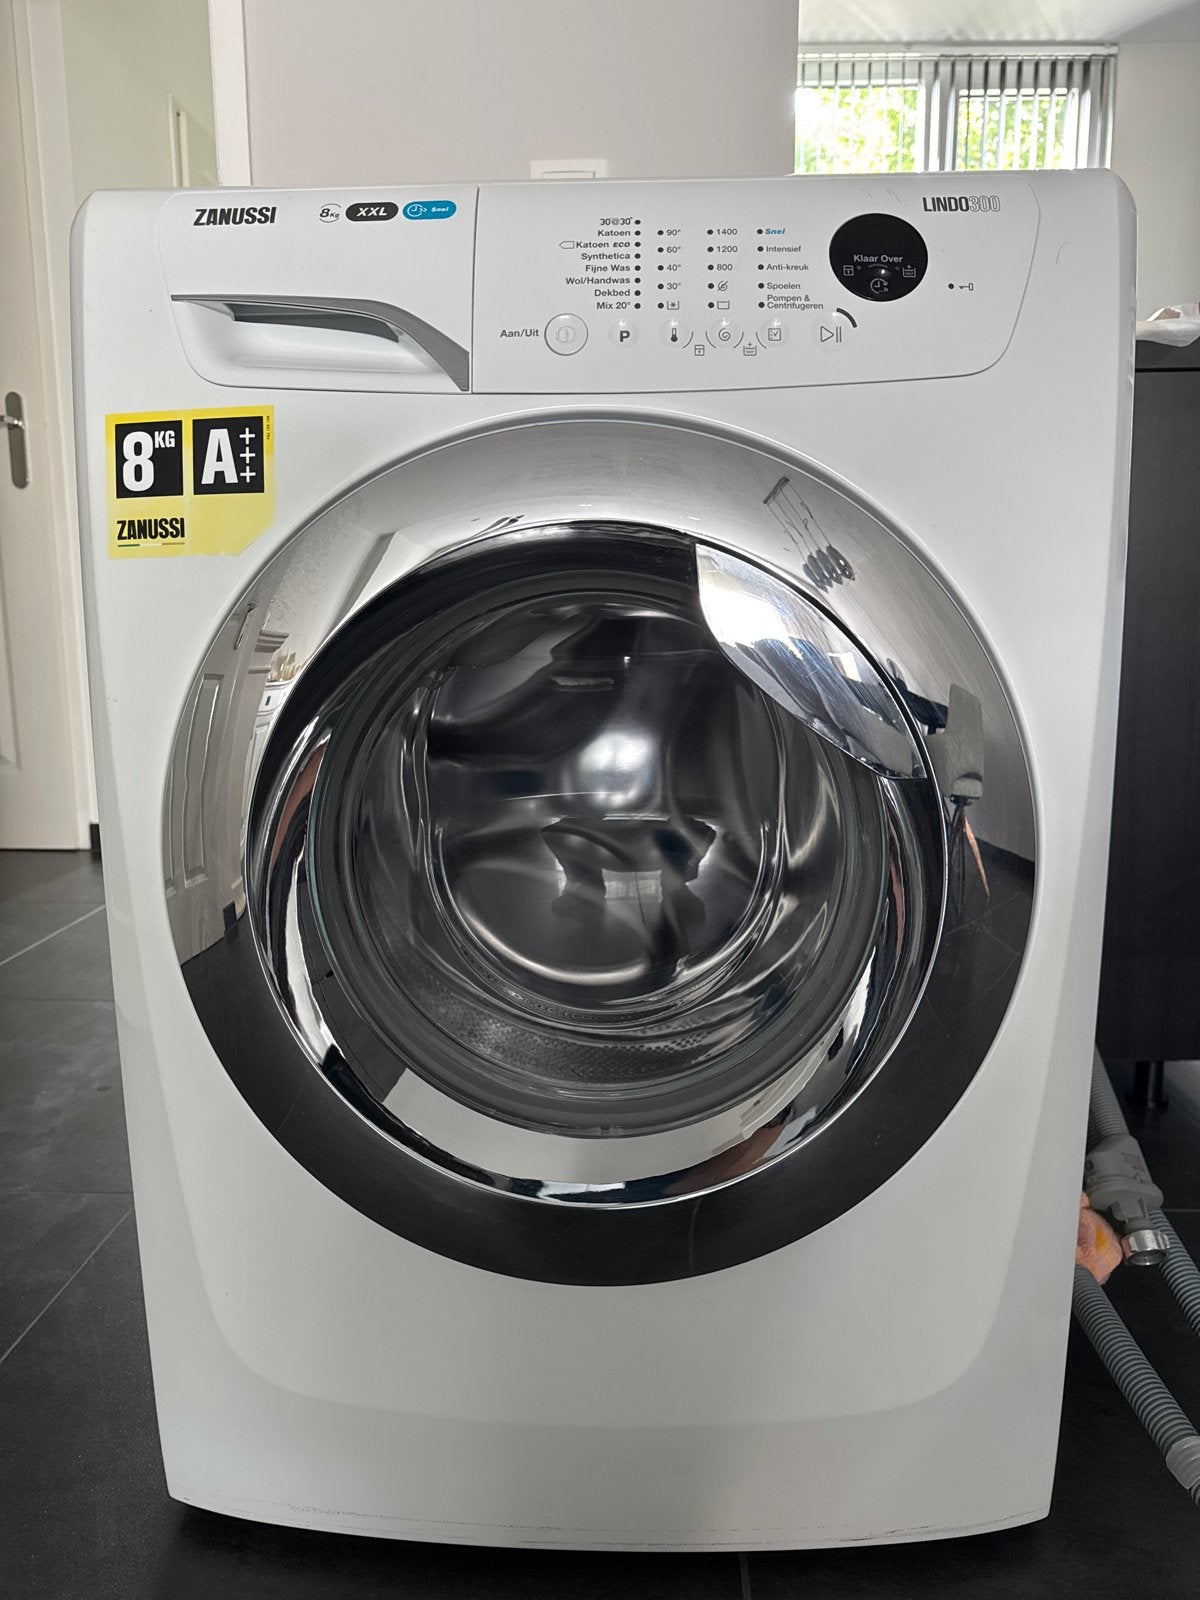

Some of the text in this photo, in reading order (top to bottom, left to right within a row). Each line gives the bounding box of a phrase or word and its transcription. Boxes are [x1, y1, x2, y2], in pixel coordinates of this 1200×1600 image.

[193, 206, 277, 226] ZANUSSI
[356, 206, 388, 217] XXL
[716, 228, 738, 236] 1400
[575, 241, 610, 249] Katoen
[766, 245, 802, 253] Intensief
[581, 252, 631, 261] Synthetica
[853, 254, 904, 262] Klaar Over
[585, 264, 631, 273] Fijne Was
[766, 263, 810, 271] Anti-kreuk
[565, 277, 631, 285] Wol/Handwas
[766, 282, 801, 291] Spoelen
[594, 289, 631, 297] Dekbed
[767, 294, 810, 302] Pompen &
[596, 301, 613, 310] Mix
[767, 301, 824, 310] Centrifugeren
[500, 329, 540, 338] Aan/Uit
[619, 330, 631, 342] P
[122, 430, 176, 492] 8 KG
[116, 517, 186, 541] ZANUSSI
